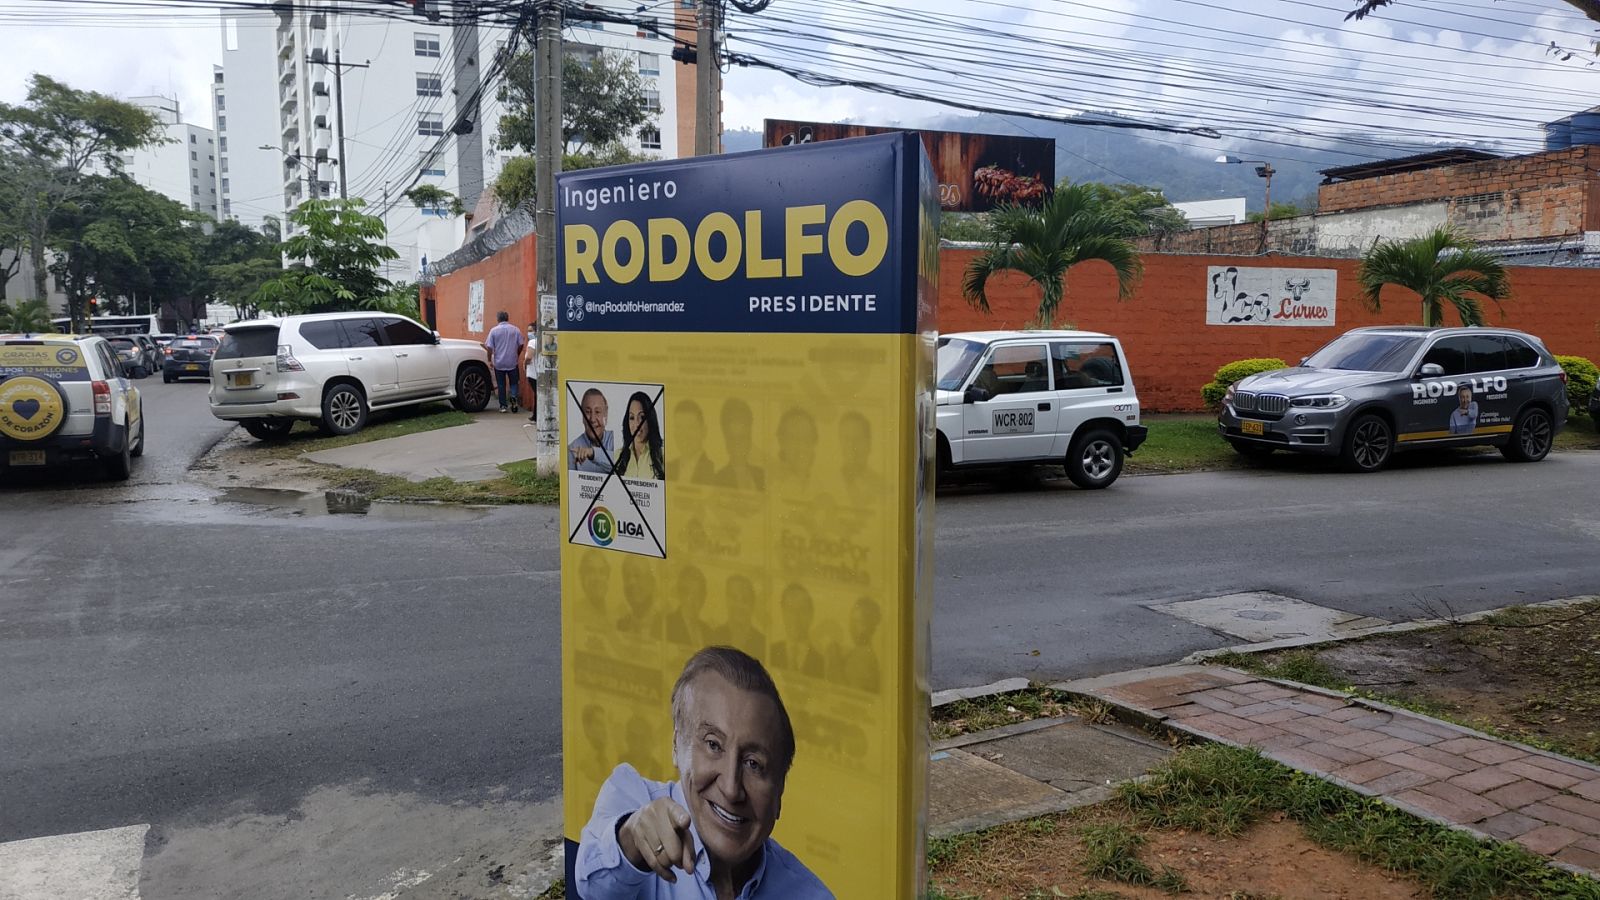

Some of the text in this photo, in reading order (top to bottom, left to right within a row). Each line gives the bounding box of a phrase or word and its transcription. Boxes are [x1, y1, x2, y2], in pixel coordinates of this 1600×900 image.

[565, 178, 677, 211] Ingeniero
[564, 199, 889, 284] RODOLFO
[585, 300, 685, 315] @IngRodolfoHernandez
[749, 294, 877, 313] PRESIDENTE
[2, 415, 13, 427] DE
[578, 474, 604, 482] PRESIDENTE
[617, 520, 645, 537] LIGA
